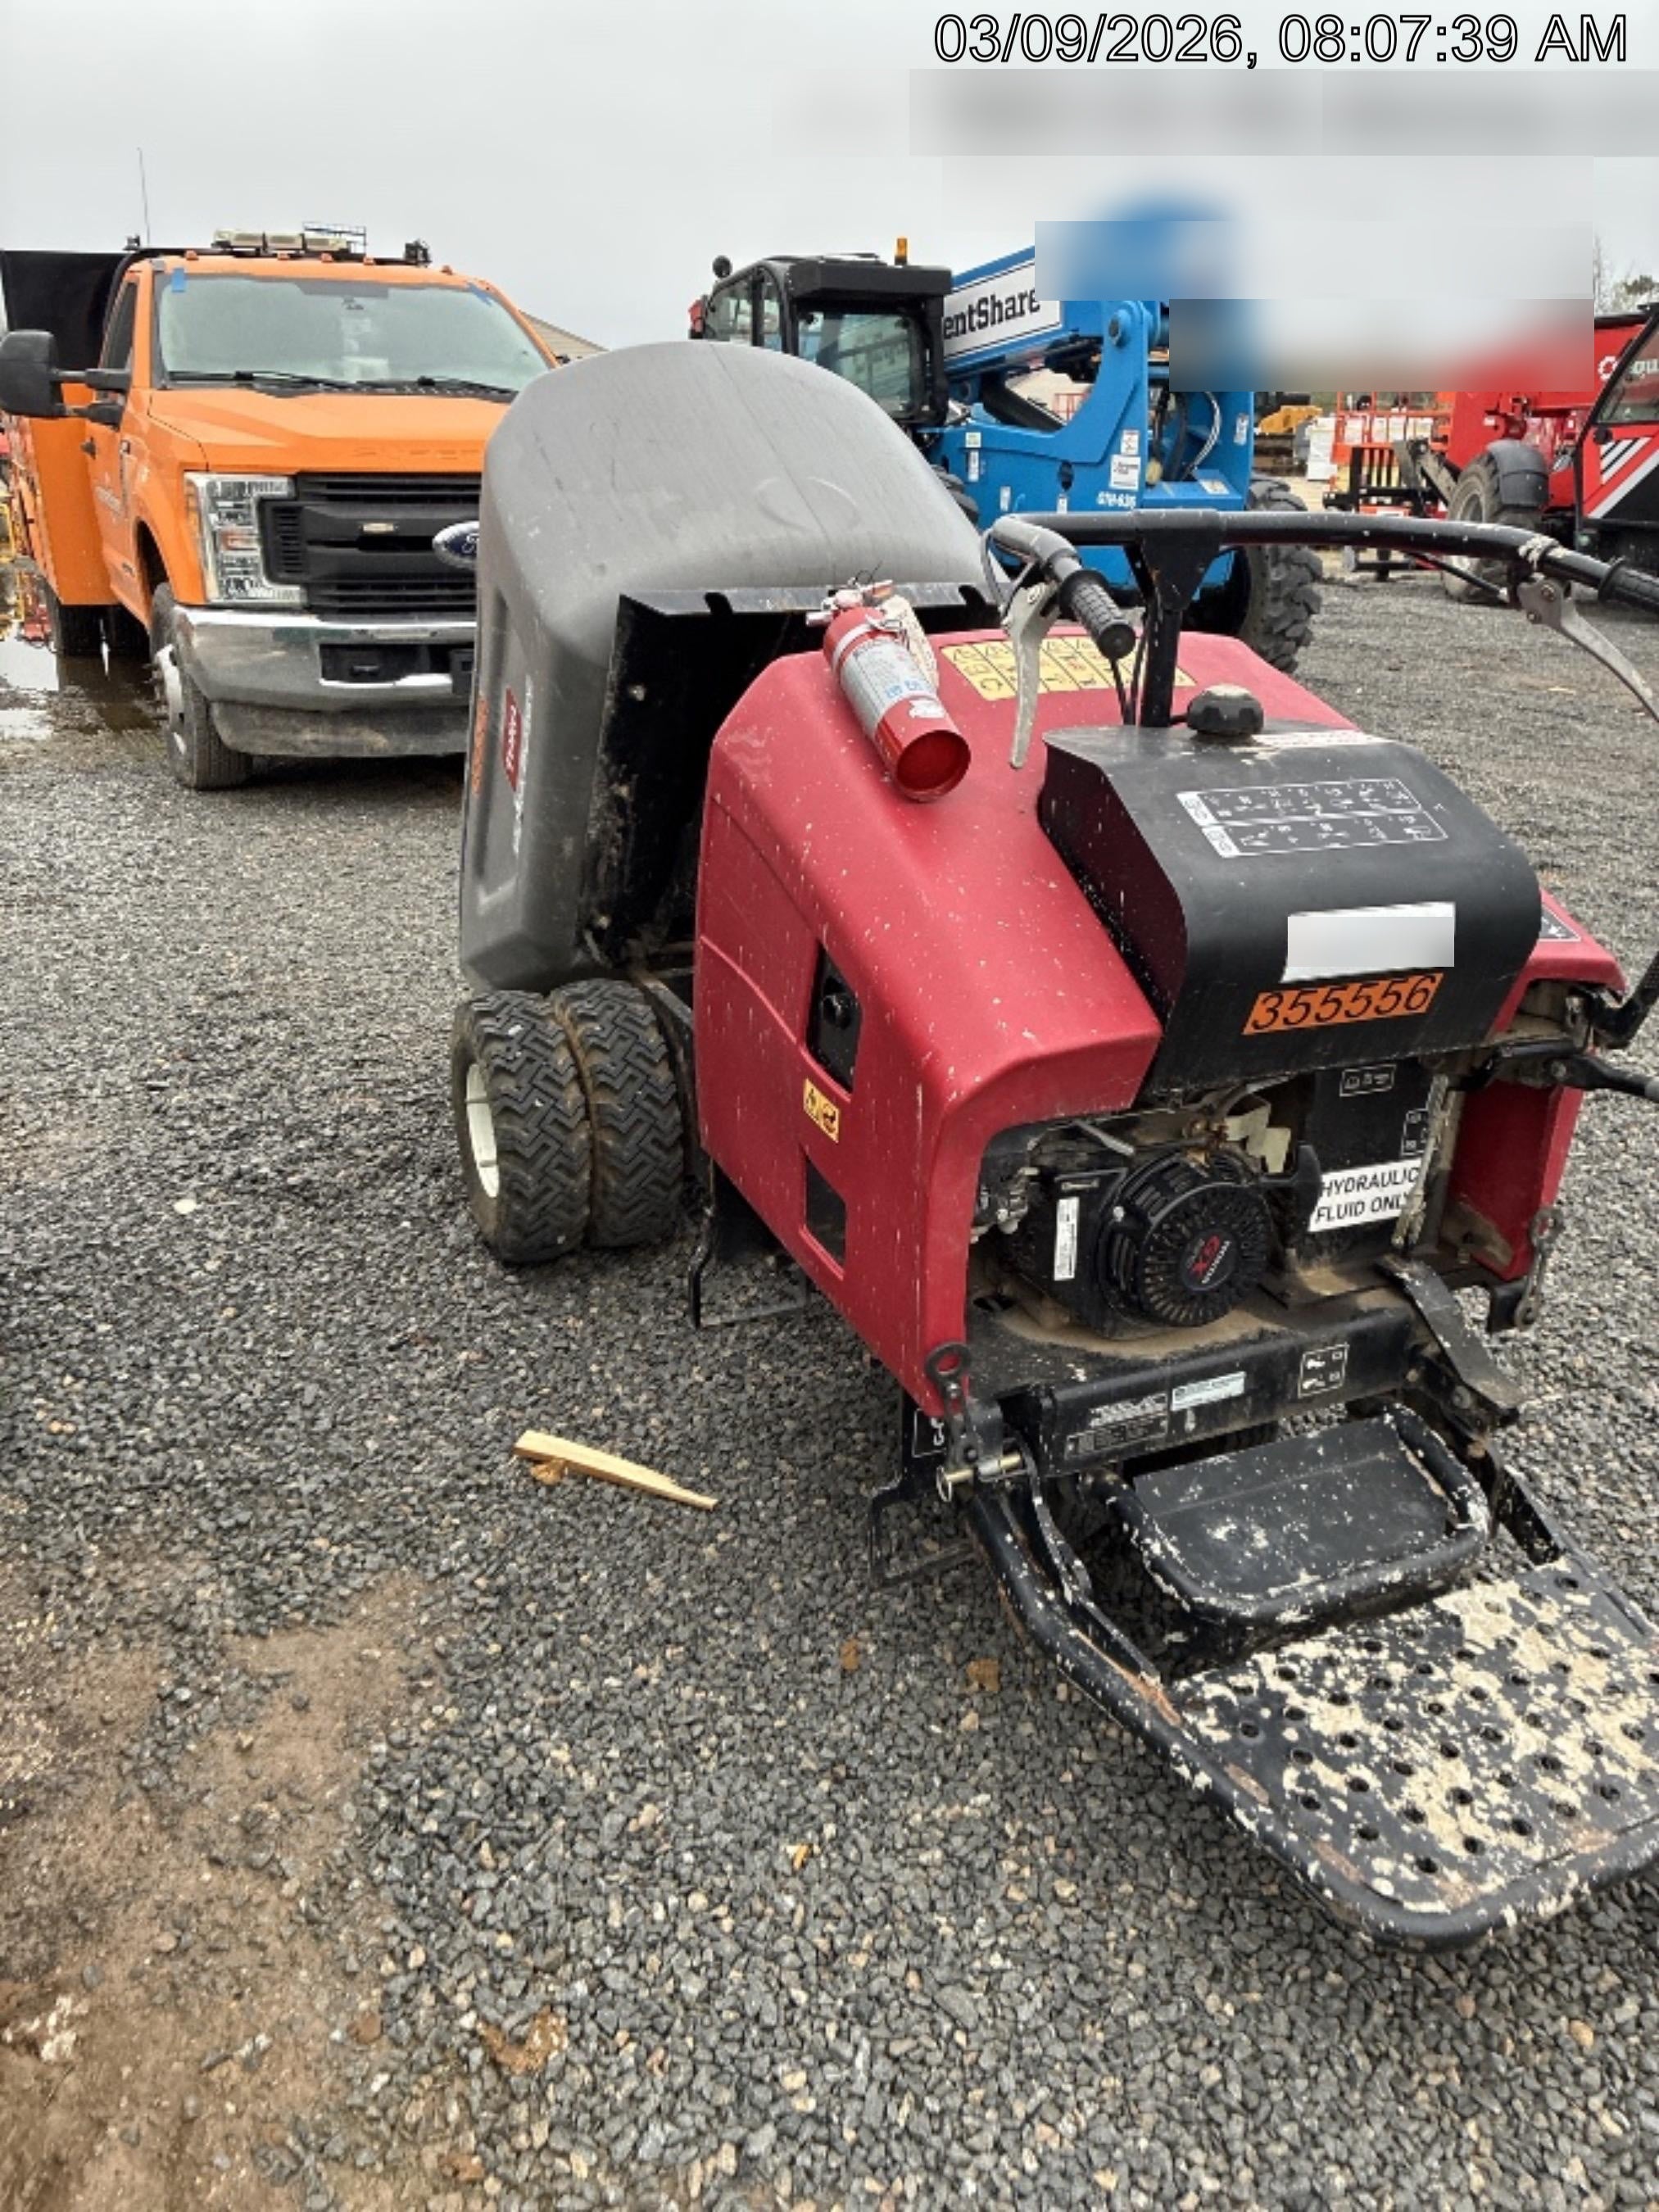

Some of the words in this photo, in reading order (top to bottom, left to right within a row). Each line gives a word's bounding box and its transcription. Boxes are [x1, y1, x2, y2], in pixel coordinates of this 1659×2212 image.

[1252, 975, 1436, 1030] 355556
[1323, 1167, 1419, 1197] HYDRAULIC
[1315, 1200, 1365, 1224] FLUID
[1371, 1192, 1408, 1213] ONL
